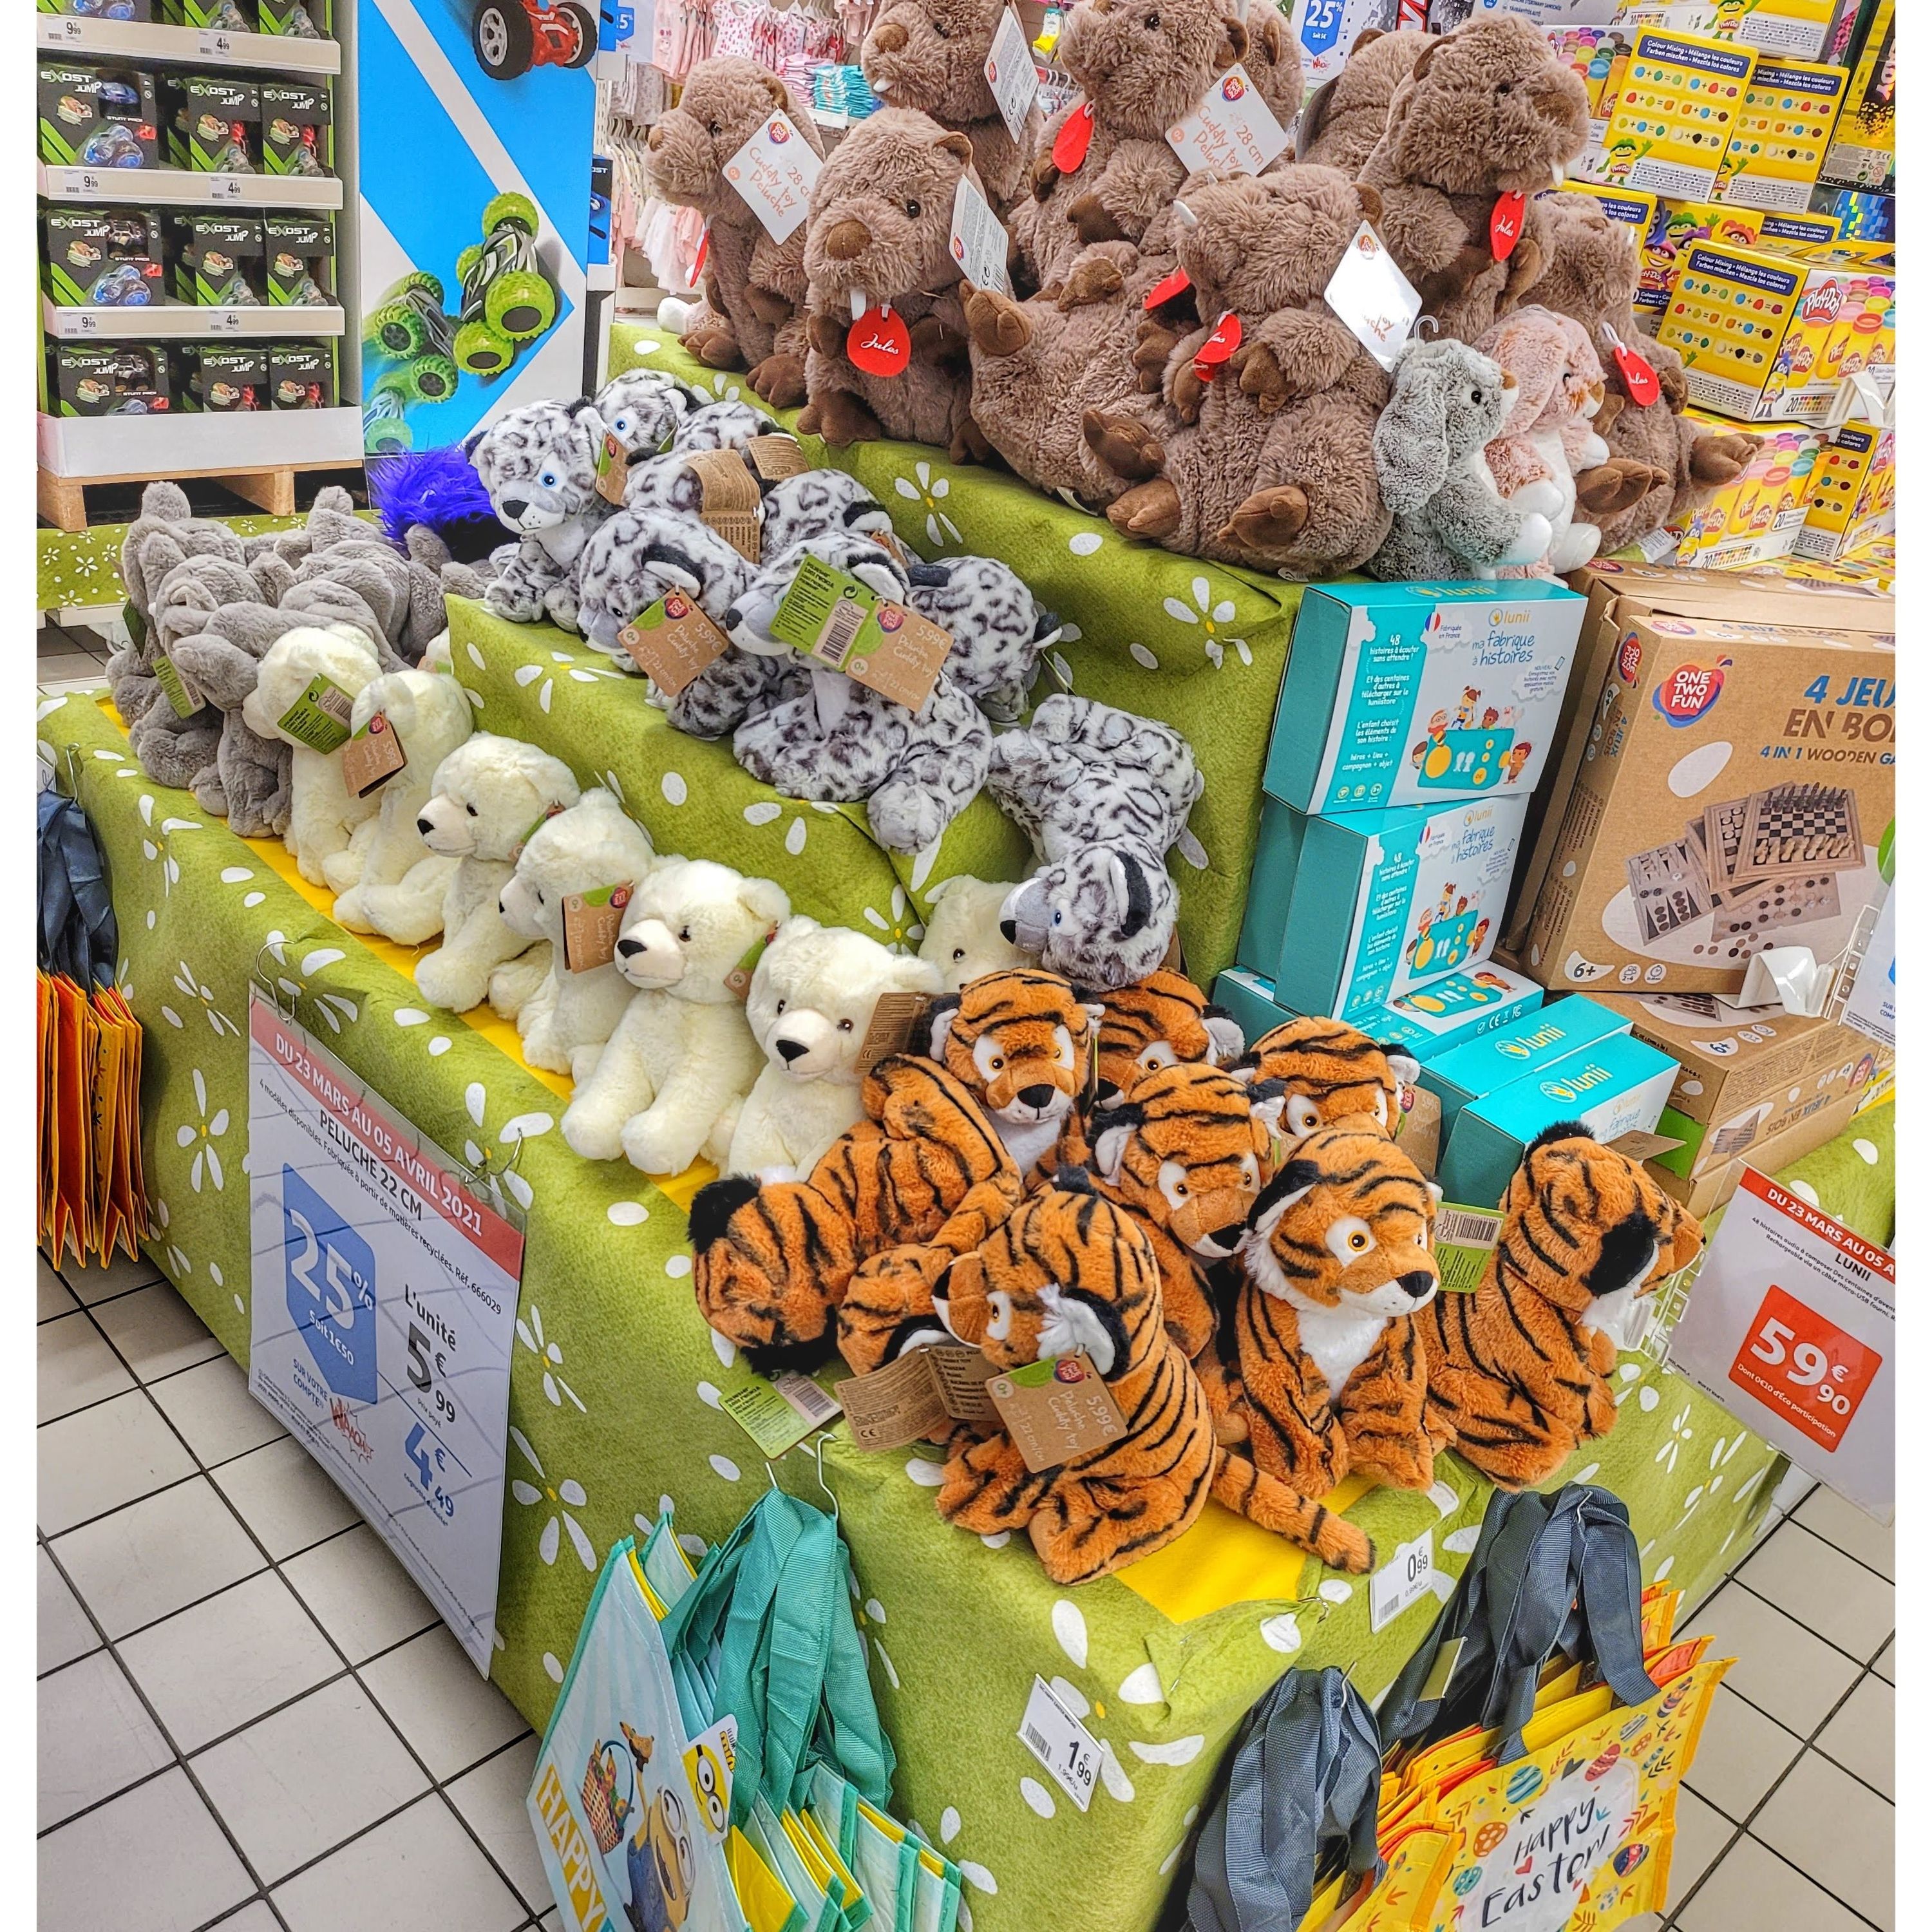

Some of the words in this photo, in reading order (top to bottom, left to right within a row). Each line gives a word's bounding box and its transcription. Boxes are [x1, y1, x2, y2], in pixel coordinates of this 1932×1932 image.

[1305, 0, 1343, 28] 25%
[1646, 47, 1666, 57] Farben
[1667, 52, 1688, 62] mischen
[1692, 56, 1710, 66] Mezcla
[1720, 62, 1739, 72] colores
[1647, 40, 1666, 51] Colour
[1667, 44, 1685, 55] Mixing
[1689, 47, 1710, 59] Mélange
[1720, 56, 1743, 66] couleurs
[41, 69, 93, 83] EXOST
[75, 80, 102, 93] JUMP
[1779, 71, 1802, 81] Mélange
[1812, 77, 1835, 86] couleurs
[1783, 79, 1803, 88] Mezcla
[1811, 83, 1832, 91] colores
[190, 84, 237, 97] EXOST
[220, 94, 245, 106] JUMP
[263, 89, 307, 101] EXOST
[292, 98, 315, 110] JUMP
[1198, 106, 1228, 149] Cuddly
[1226, 148, 1242, 172] toy
[1236, 124, 1251, 146] 28
[1249, 146, 1264, 166] cm
[1193, 131, 1224, 169] Peluc
[750, 147, 782, 187] Cuddly
[781, 186, 797, 207] toy
[787, 167, 802, 185] 28
[750, 170, 784, 217] Peluche
[1617, 204, 1641, 213] couleurs
[1617, 211, 1638, 219] colores
[51, 216, 101, 229] EXOST
[84, 225, 110, 237] JUMP
[196, 223, 240, 234] EXOST
[269, 225, 310, 236] EXOST
[1495, 214, 1513, 237] Jules
[225, 230, 249, 242] JUMP
[296, 232, 318, 243] JUMP
[1696, 260, 1715, 270] Farben
[1716, 266, 1736, 278] mischen
[1739, 272, 1758, 283] Mezcla
[1766, 279, 1786, 290] colores
[1697, 254, 1714, 264] Colour
[1715, 257, 1732, 269] Mixing
[1736, 263, 1759, 276] Mélange
[1766, 272, 1790, 284] couleurs
[860, 333, 899, 355] Jules
[62, 356, 109, 368] EXOST
[93, 363, 118, 374] JUMP
[204, 354, 247, 366] EXOST
[231, 360, 254, 373] JUMP
[272, 354, 312, 365] EXOST
[298, 359, 319, 371] JUMP
[1786, 397, 1798, 412] 20
[1841, 433, 1864, 442] couleurs
[1841, 439, 1861, 448] colores
[1774, 514, 1785, 528] 20
[1504, 610, 1531, 624] lunii
[667, 634, 690, 658] Cuddly
[675, 624, 699, 653] Peluche
[696, 623, 721, 651] 5,99€
[916, 625, 948, 650] 5,99€
[1390, 634, 1401, 645] 48
[1472, 640, 1485, 650] ma
[1487, 630, 1535, 651] fabrique
[893, 646, 922, 670] Cuddly
[1480, 648, 1533, 666] histoires
[1675, 670, 1712, 685] ONE
[1361, 690, 1392, 699] télécharger
[1674, 683, 1707, 696] TWO
[1804, 675, 1830, 703] 4
[1368, 697, 1396, 706] luniistore
[1671, 695, 1704, 709] FUN
[1783, 708, 1835, 739] EN
[1611, 728, 1624, 757] JEUX
[1760, 746, 1770, 757] 4
[1772, 746, 1790, 759] IN
[1807, 748, 1877, 764] WOODEN
[1342, 762, 1372, 772] compagnon
[1474, 808, 1492, 822] lunii
[1462, 826, 1495, 846] fabrique
[1394, 853, 1402, 864] 48
[1455, 838, 1493, 864] histoires
[1573, 963, 1596, 978] 6+
[1520, 1024, 1567, 1050] lunii
[1569, 1064, 1613, 1092] lunii
[276, 1033, 294, 1063] DU
[295, 1052, 310, 1079] 23
[313, 1067, 350, 1116] MARS
[352, 1105, 372, 1136] AU
[374, 1126, 392, 1155] 05
[394, 1144, 439, 1199] AVRIL
[441, 1186, 482, 1236] 2021
[320, 1108, 377, 1180] PELUCHE
[380, 1167, 397, 1199] 22
[401, 1188, 422, 1221] CM
[265, 1086, 287, 1113] modèles
[324, 1140, 354, 1178] Fabriquée
[361, 1179, 379, 1204] partir
[389, 1208, 419, 1240] matières
[420, 1236, 454, 1273] recyclées.
[455, 1267, 470, 1288] Réf.
[471, 1283, 502, 1315] 666029
[1767, 1188, 1788, 1207] DU
[1786, 1201, 1805, 1218] 23
[1804, 1212, 1844, 1243] MARS
[1842, 1238, 1865, 1256] AU
[1865, 1251, 1883, 1267] 05
[1759, 1221, 1783, 1240] histoires
[1784, 1235, 1800, 1251] audio
[1805, 1253, 1833, 1273] composer
[1833, 1267, 1844, 1276] Des
[1844, 1276, 1872, 1296] centaines
[1766, 1234, 1803, 1261] Rechargeable
[1803, 1258, 1813, 1268] via
[1821, 1268, 1837, 1284] câble
[1837, 1280, 1870, 1303] micro-USB
[1835, 1253, 1871, 1282] LUNII
[290, 1209, 374, 1331] 25%
[404, 1283, 457, 1352] L'unité
[309, 1310, 328, 1339] Soit
[329, 1331, 354, 1366] 1€50
[294, 1359, 306, 1379] SUR
[307, 1372, 328, 1402] VOTRE
[1060, 1390, 1086, 1430] Peluche
[1738, 1363, 1755, 1380] Dont
[1755, 1374, 1773, 1392] 0€10
[1773, 1390, 1792, 1406] d'Éco
[1791, 1402, 1836, 1438] participation
[1048, 1397, 1072, 1431] Cuddly
[1086, 1396, 1118, 1437] 5,99€
[1514, 1797, 1596, 1865] Happy
[539, 1774, 605, 1931] HAPPY
[1481, 1824, 1610, 1928] Easter!
